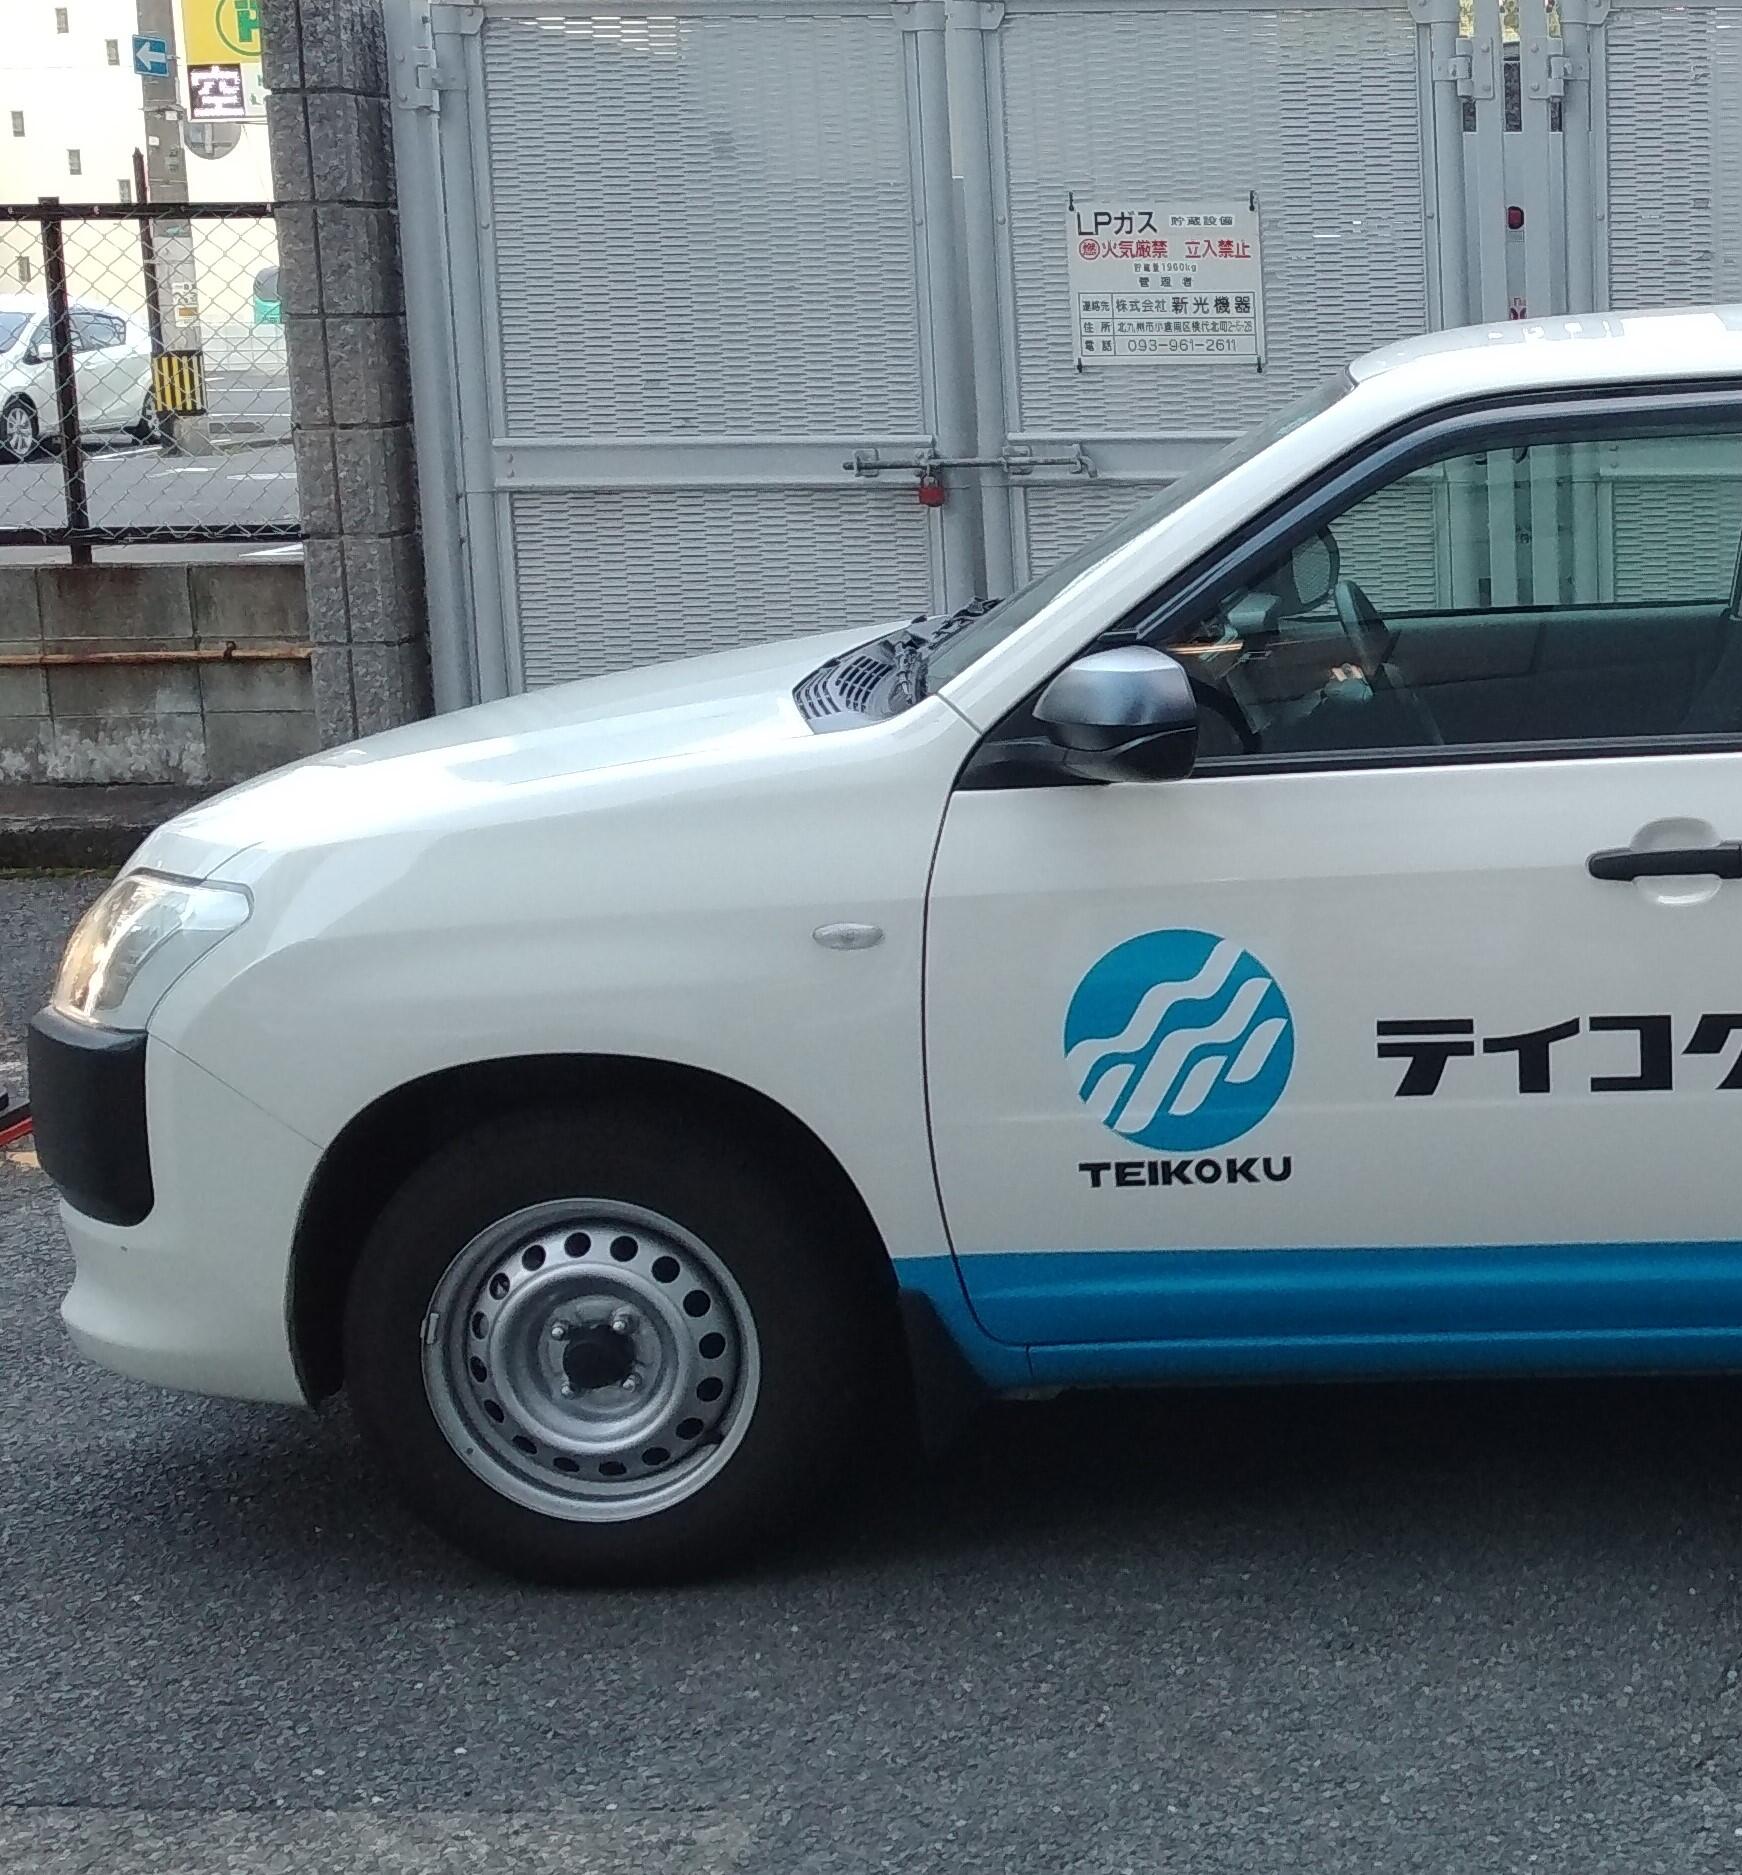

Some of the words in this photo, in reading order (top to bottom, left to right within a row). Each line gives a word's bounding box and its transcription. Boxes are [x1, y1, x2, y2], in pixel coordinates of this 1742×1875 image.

[1077, 210, 1158, 236] LPガス
[1185, 239, 1251, 259] 立入禁止
[1128, 339, 1237, 353] 093-961-2611
[1078, 1156, 1294, 1189] TEIKOKU
